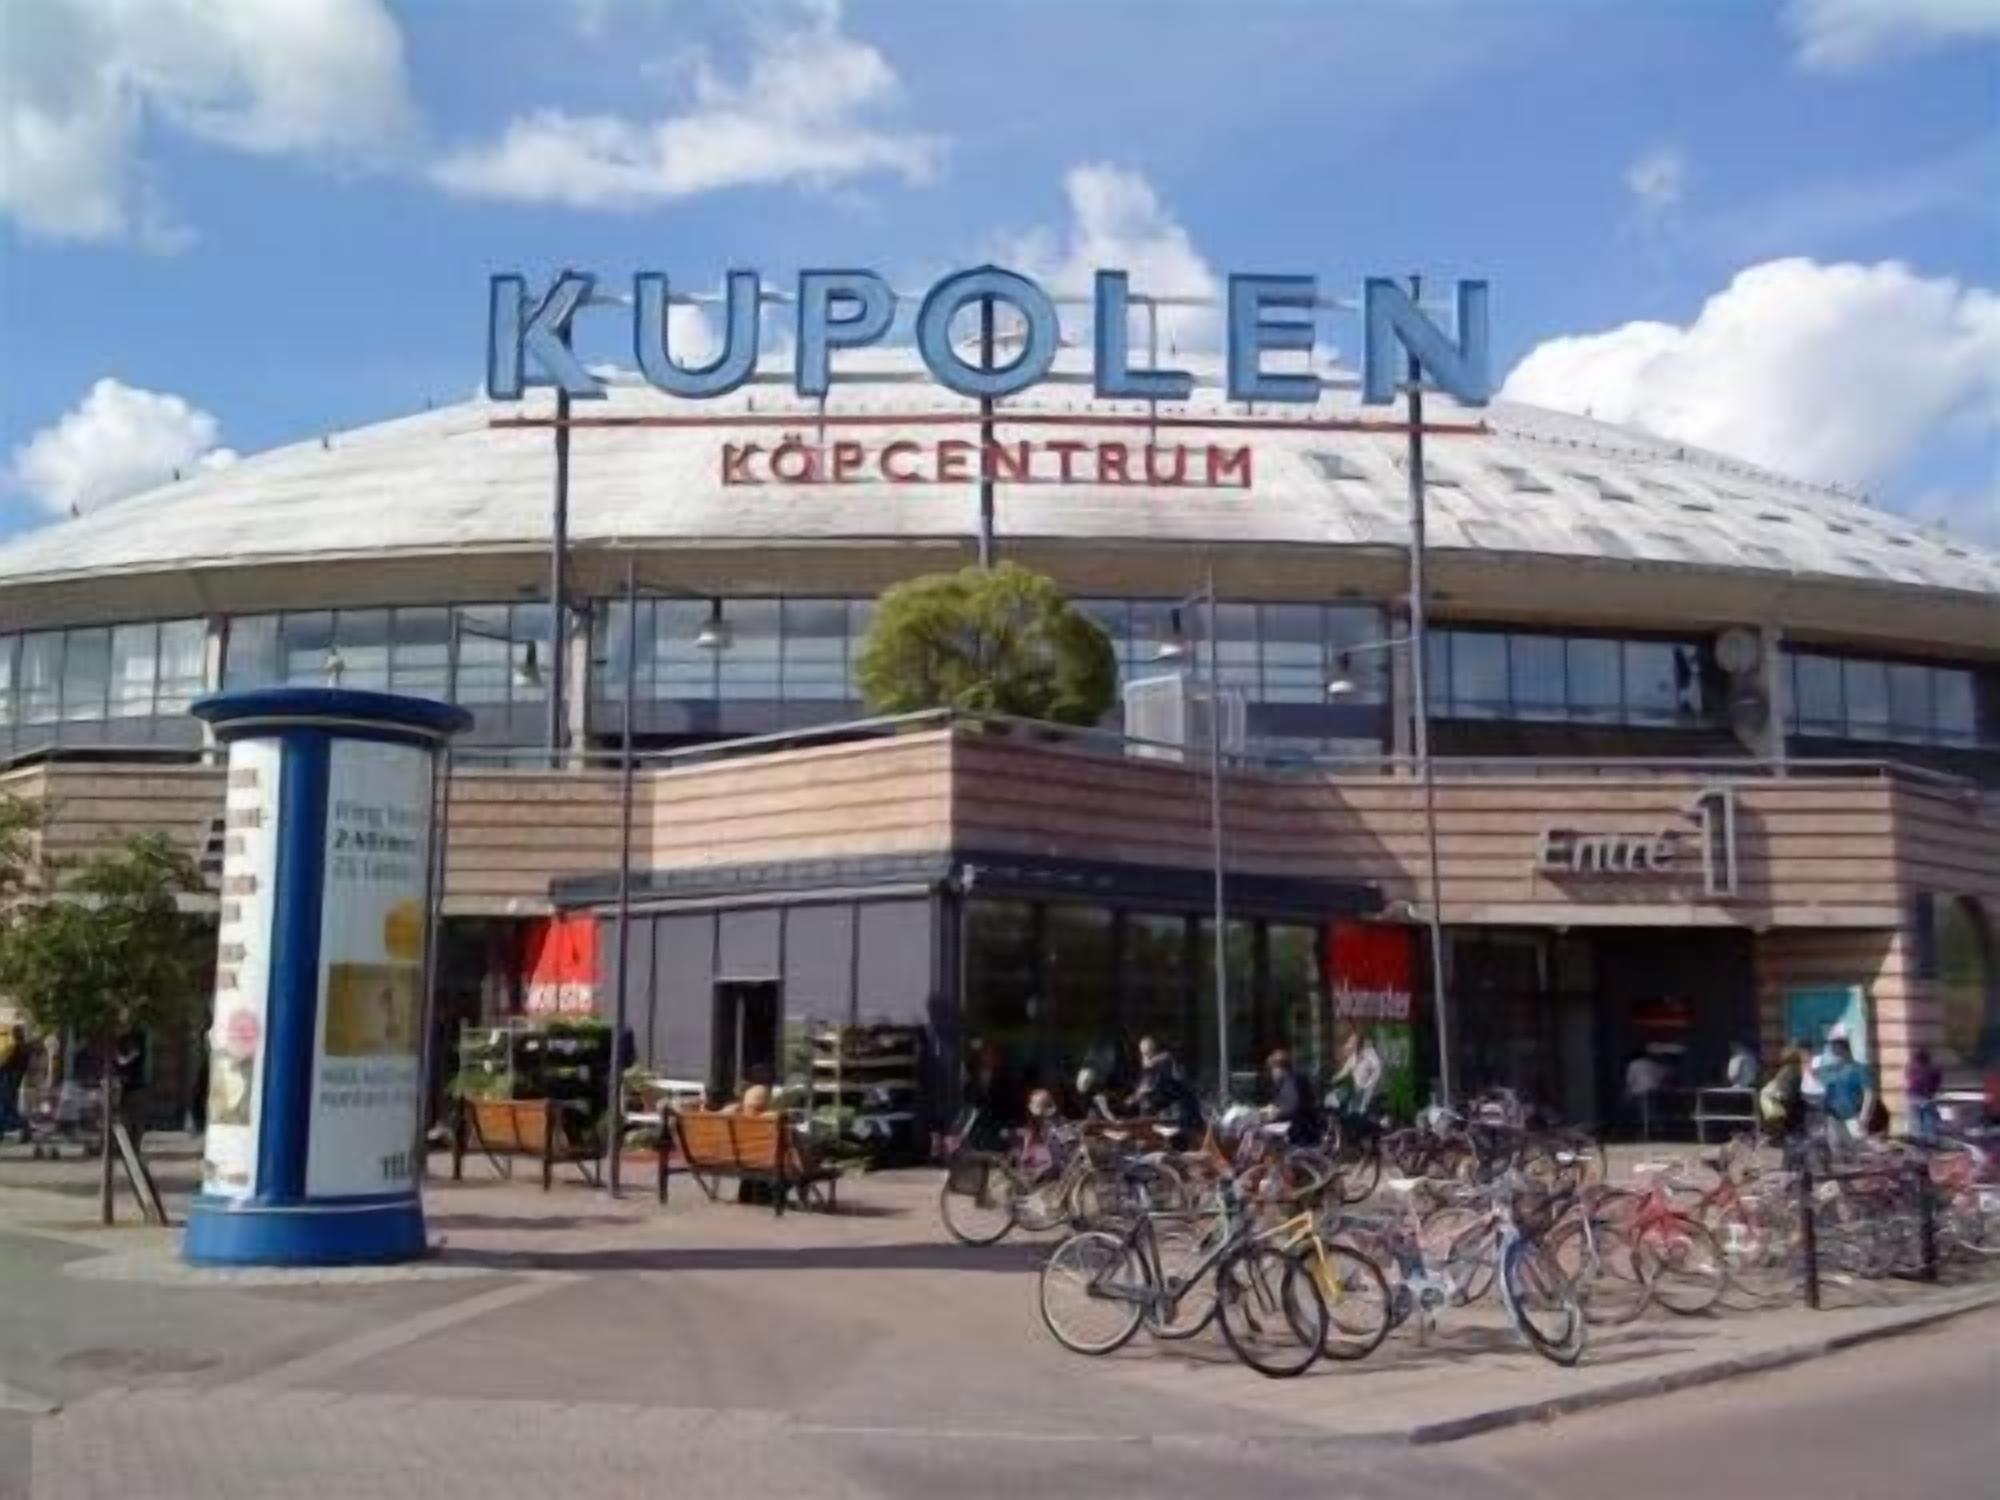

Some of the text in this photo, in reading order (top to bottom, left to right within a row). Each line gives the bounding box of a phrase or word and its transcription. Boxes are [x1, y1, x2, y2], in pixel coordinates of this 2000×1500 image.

[486, 265, 1491, 405] KUPOLEN
[721, 440, 1253, 487] KÖPCENTRUM
[1536, 786, 1738, 898] Entré 1
